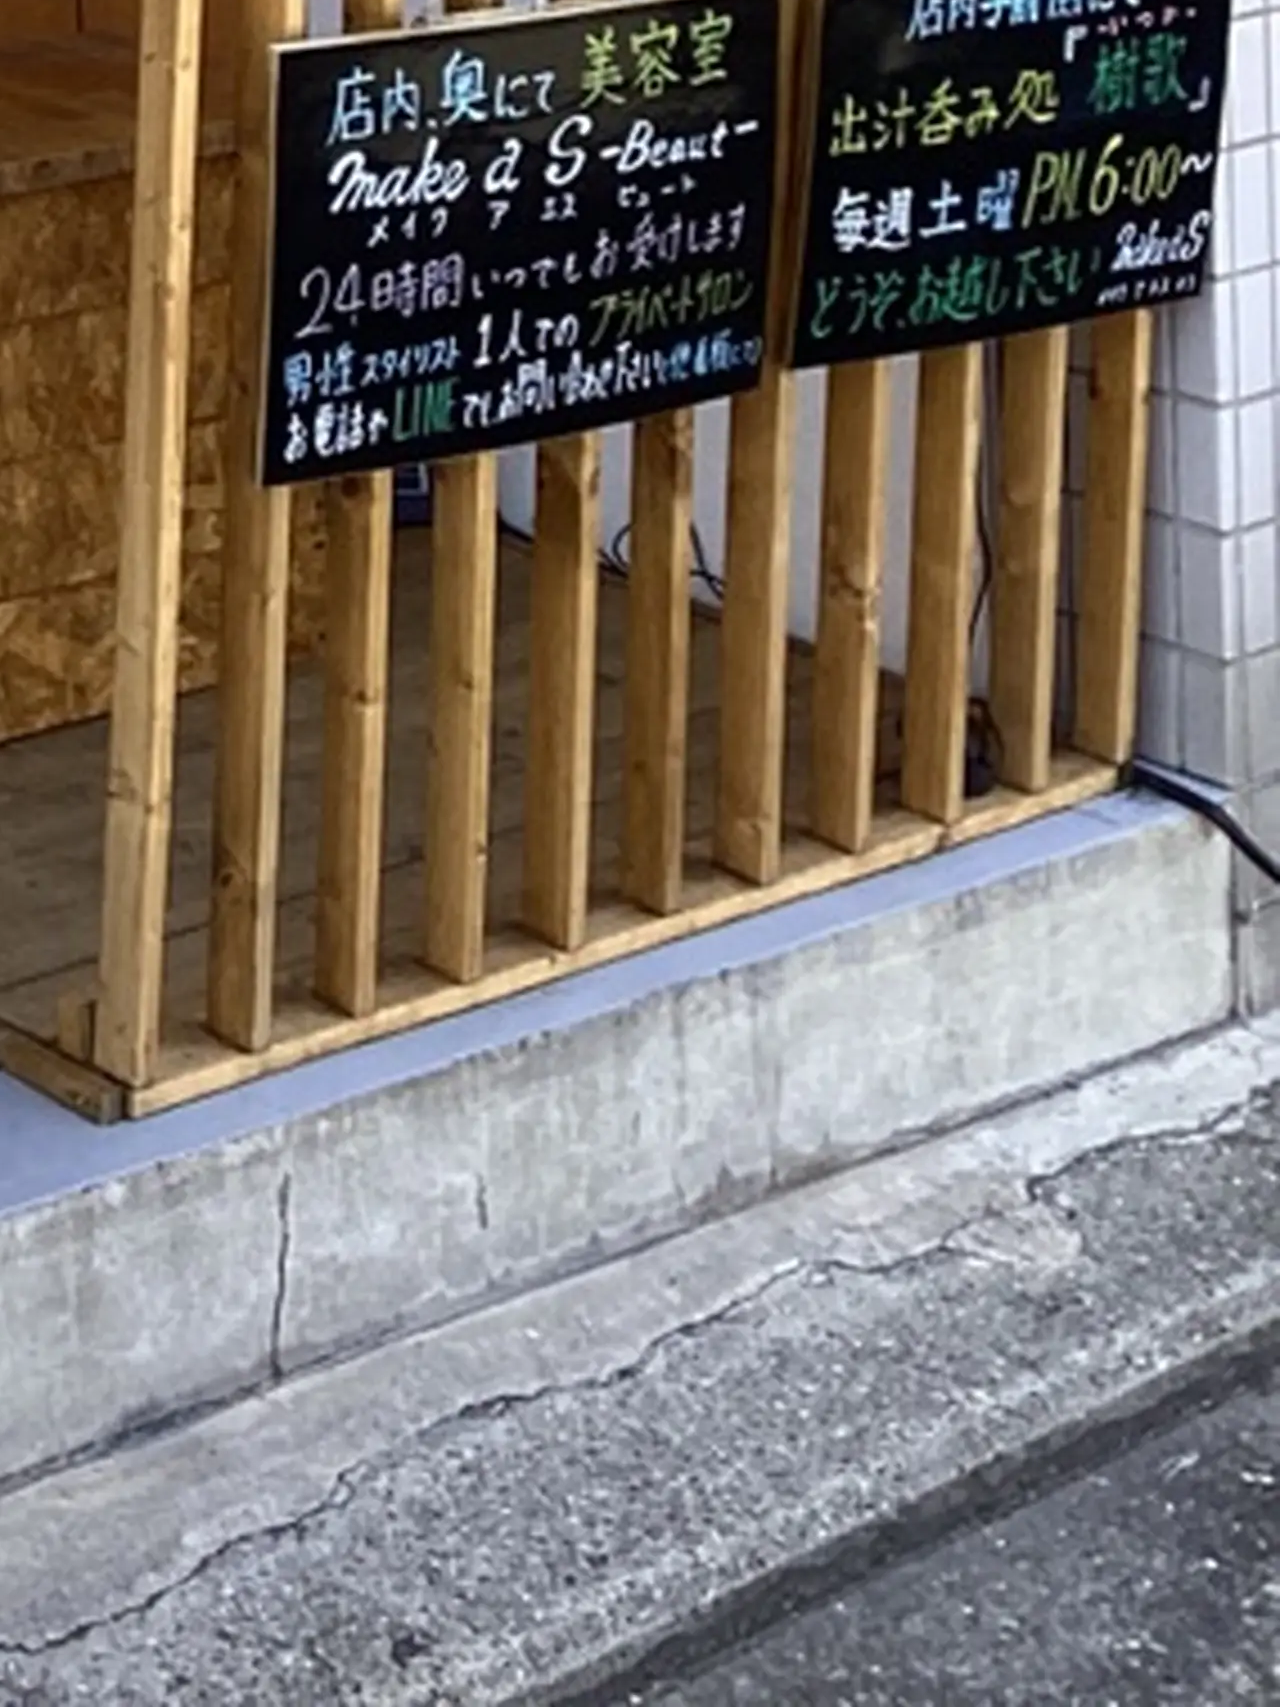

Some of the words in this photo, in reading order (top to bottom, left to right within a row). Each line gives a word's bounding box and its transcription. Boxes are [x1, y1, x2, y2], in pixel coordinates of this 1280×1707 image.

[580, 8, 735, 110] 美容室
[327, 136, 470, 214] make
